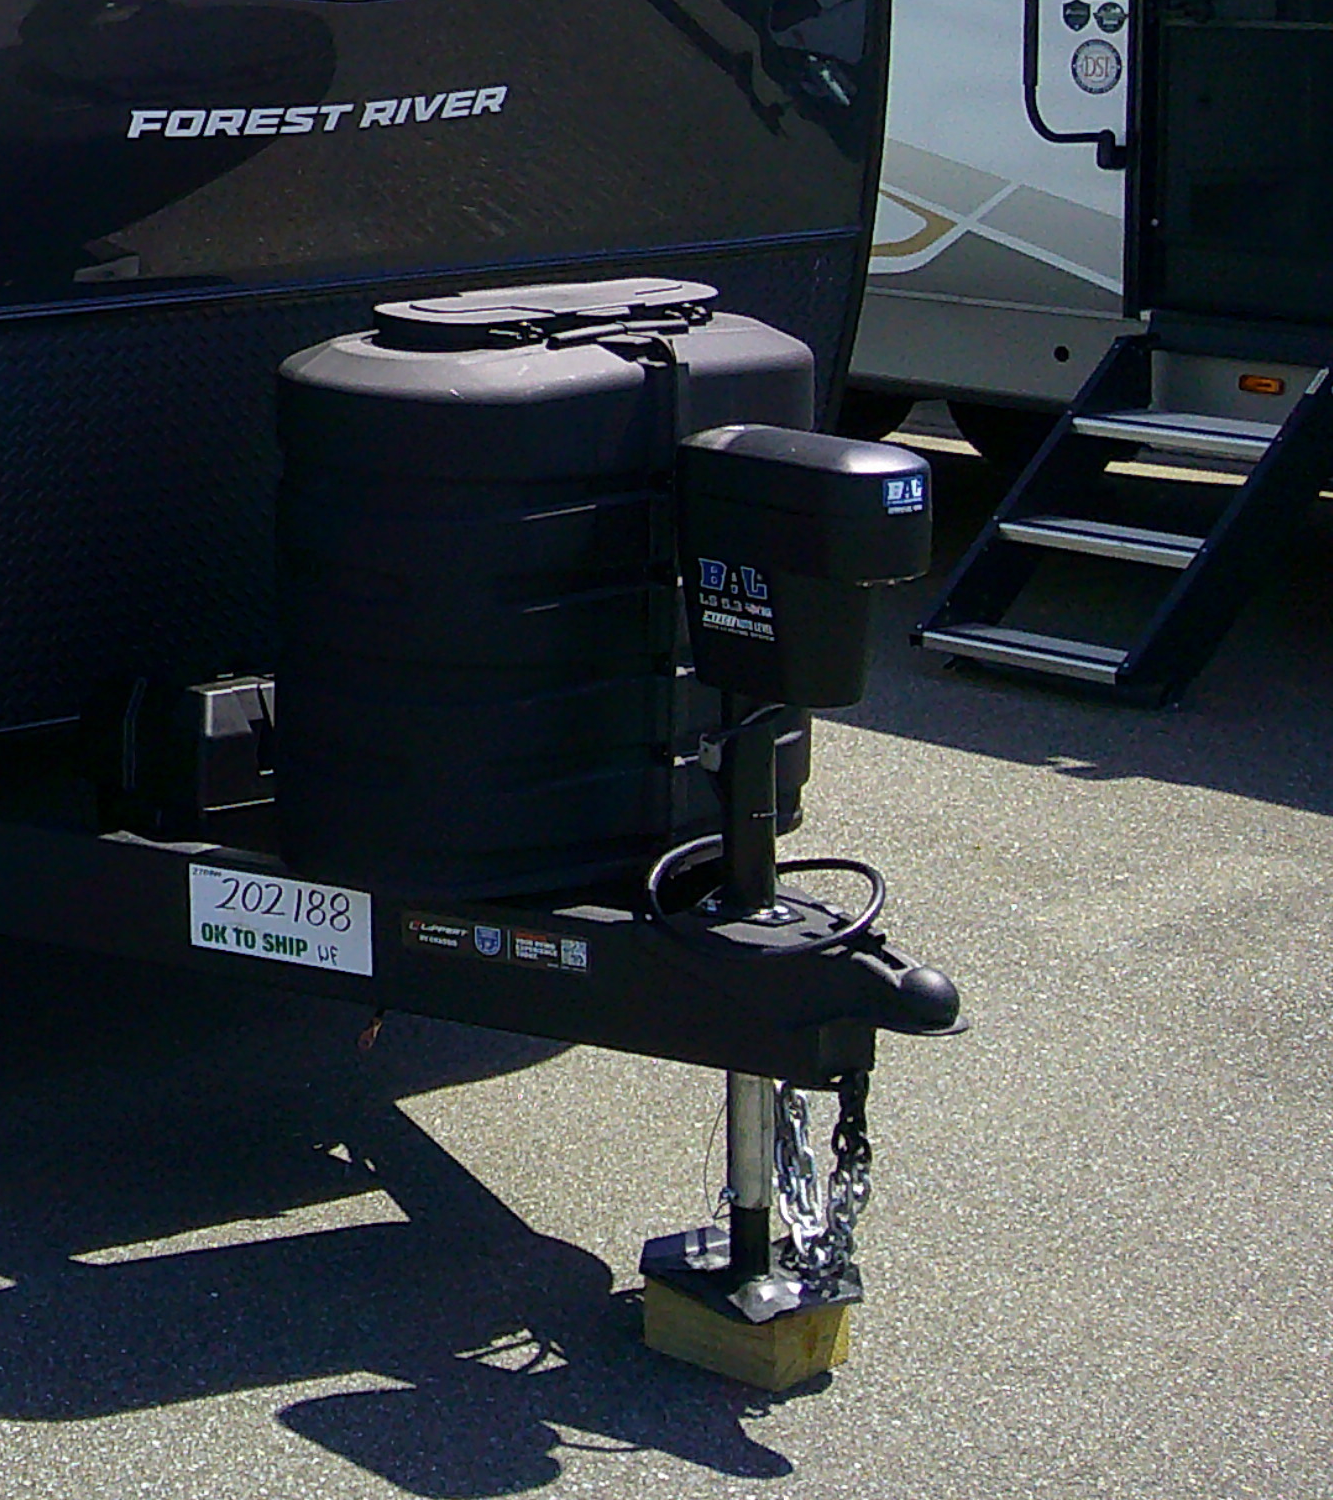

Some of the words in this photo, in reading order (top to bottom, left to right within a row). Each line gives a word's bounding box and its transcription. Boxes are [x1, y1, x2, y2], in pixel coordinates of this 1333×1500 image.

[126, 103, 355, 138] FOREST
[358, 84, 508, 129] RIVER
[214, 877, 352, 933] 202188
[200, 921, 229, 945] OK
[231, 926, 257, 950] TO
[261, 932, 309, 958] SHIP
